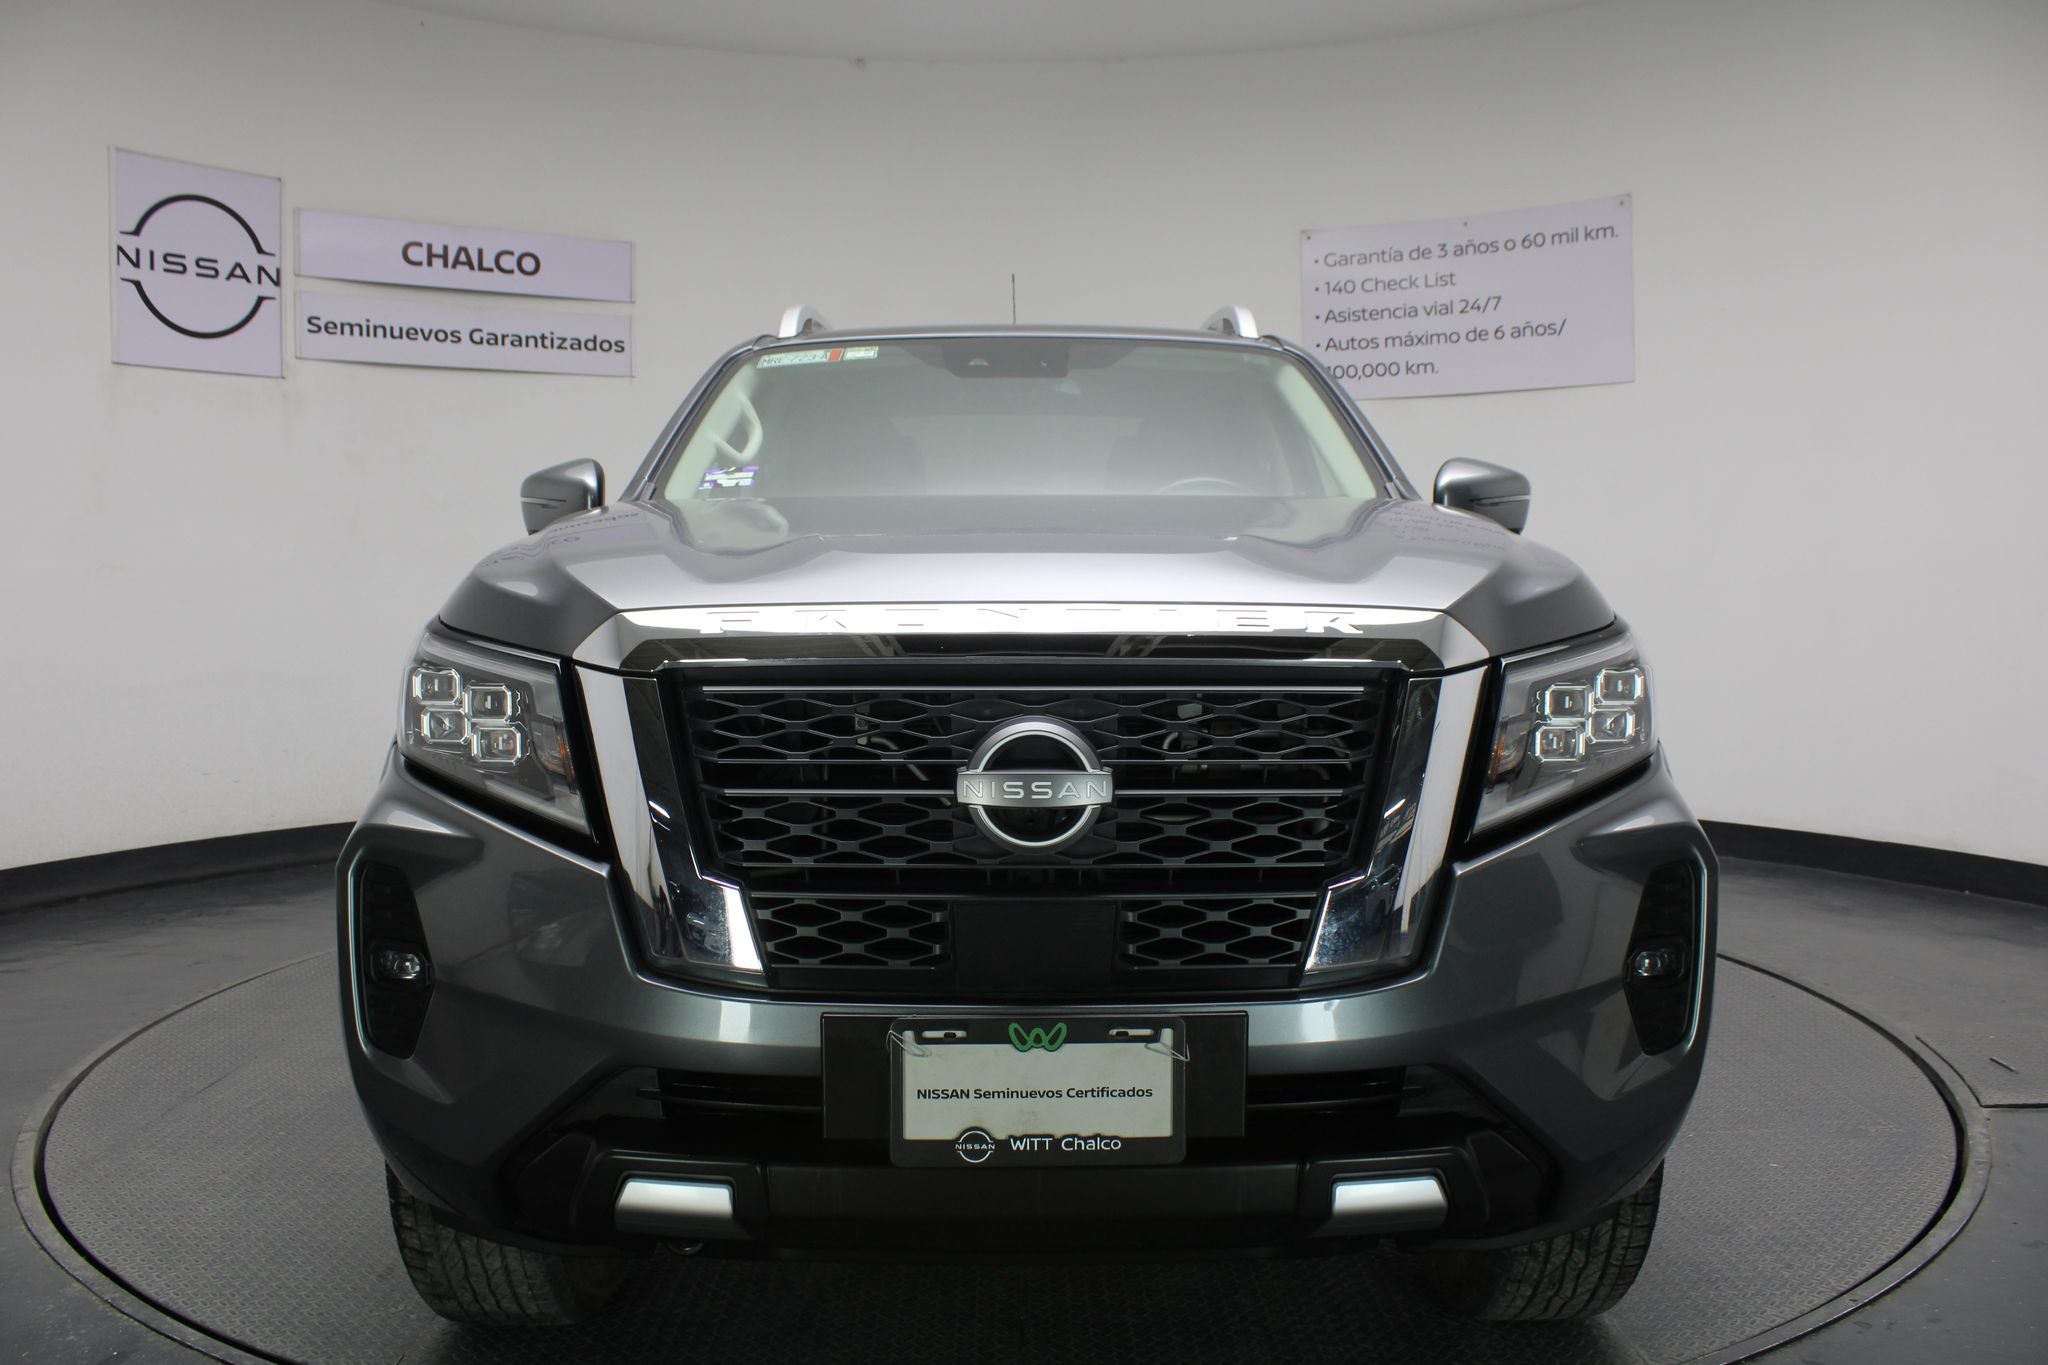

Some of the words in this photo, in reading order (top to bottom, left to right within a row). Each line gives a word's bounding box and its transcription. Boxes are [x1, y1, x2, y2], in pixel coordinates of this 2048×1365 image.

[401, 241, 542, 276] CHALCO
[1323, 247, 1404, 268] Garantía
[1408, 245, 1433, 261] de
[1437, 243, 1449, 259] 3
[1453, 238, 1500, 257] años
[1503, 239, 1517, 251] o
[1521, 232, 1546, 250] 60
[1551, 227, 1579, 245] mil
[1583, 224, 1619, 242] km.
[116, 244, 281, 287] NISSAN
[1324, 279, 1356, 296] 140
[1361, 274, 1420, 294] Check
[1424, 271, 1457, 289] List
[1324, 304, 1419, 324] Asistencia
[1423, 299, 1454, 317] vial
[1458, 295, 1502, 315] 24/7
[306, 315, 462, 344] Seminuevos
[468, 328, 626, 353] Garantizados
[1325, 336, 1380, 352] Autos
[1384, 329, 1461, 349] máximo
[1465, 326, 1490, 342] de
[1493, 325, 1505, 340] 6
[1510, 318, 1568, 339] años/
[1405, 361, 1439, 376] km.
[962, 780, 1107, 800] NISSAN
[916, 1088, 970, 1100] NISSAN
[974, 1087, 1063, 1100] Seminuevos
[1066, 1086, 1153, 1099] Certificados
[1010, 1138, 1053, 1151] WITT
[1061, 1136, 1122, 1151] Chalco
